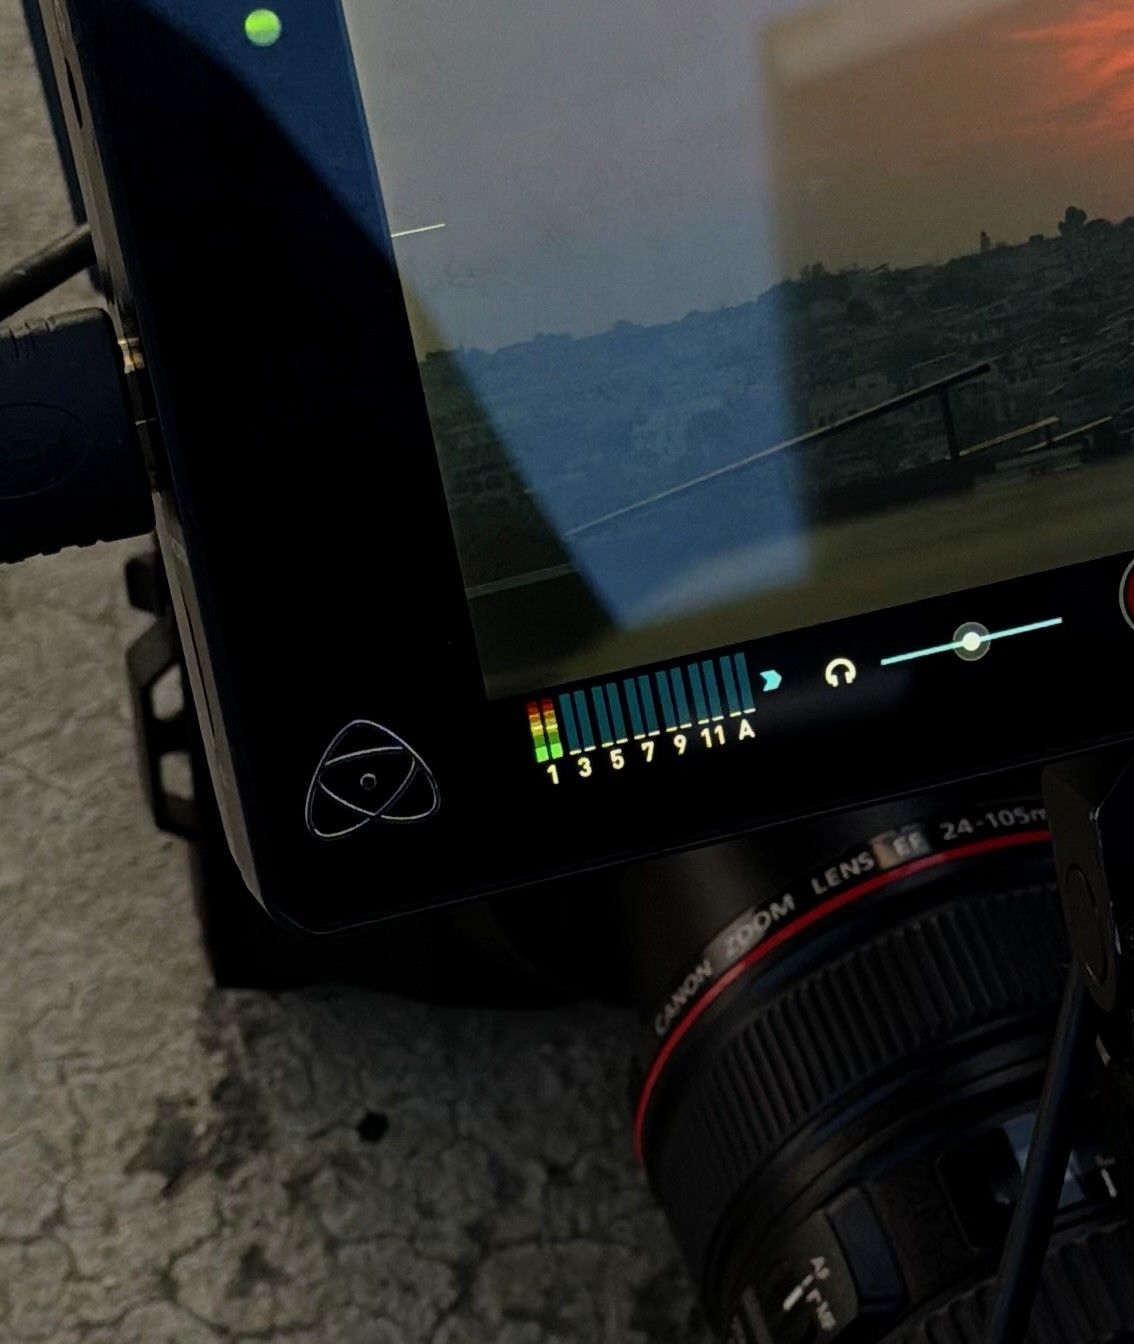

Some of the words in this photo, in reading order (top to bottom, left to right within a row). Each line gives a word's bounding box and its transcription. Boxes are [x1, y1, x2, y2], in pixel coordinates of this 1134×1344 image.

[547, 764, 560, 784] 1
[578, 757, 593, 778] 3
[610, 749, 625, 770] 5
[641, 741, 655, 762] 7
[674, 734, 687, 755] 9
[701, 724, 727, 748] 11
[738, 718, 756, 740] A
[655, 959, 713, 1036] CANON
[726, 893, 797, 958] ZOOM
[810, 851, 876, 897] LENS
[937, 807, 1048, 841] 24-105m
